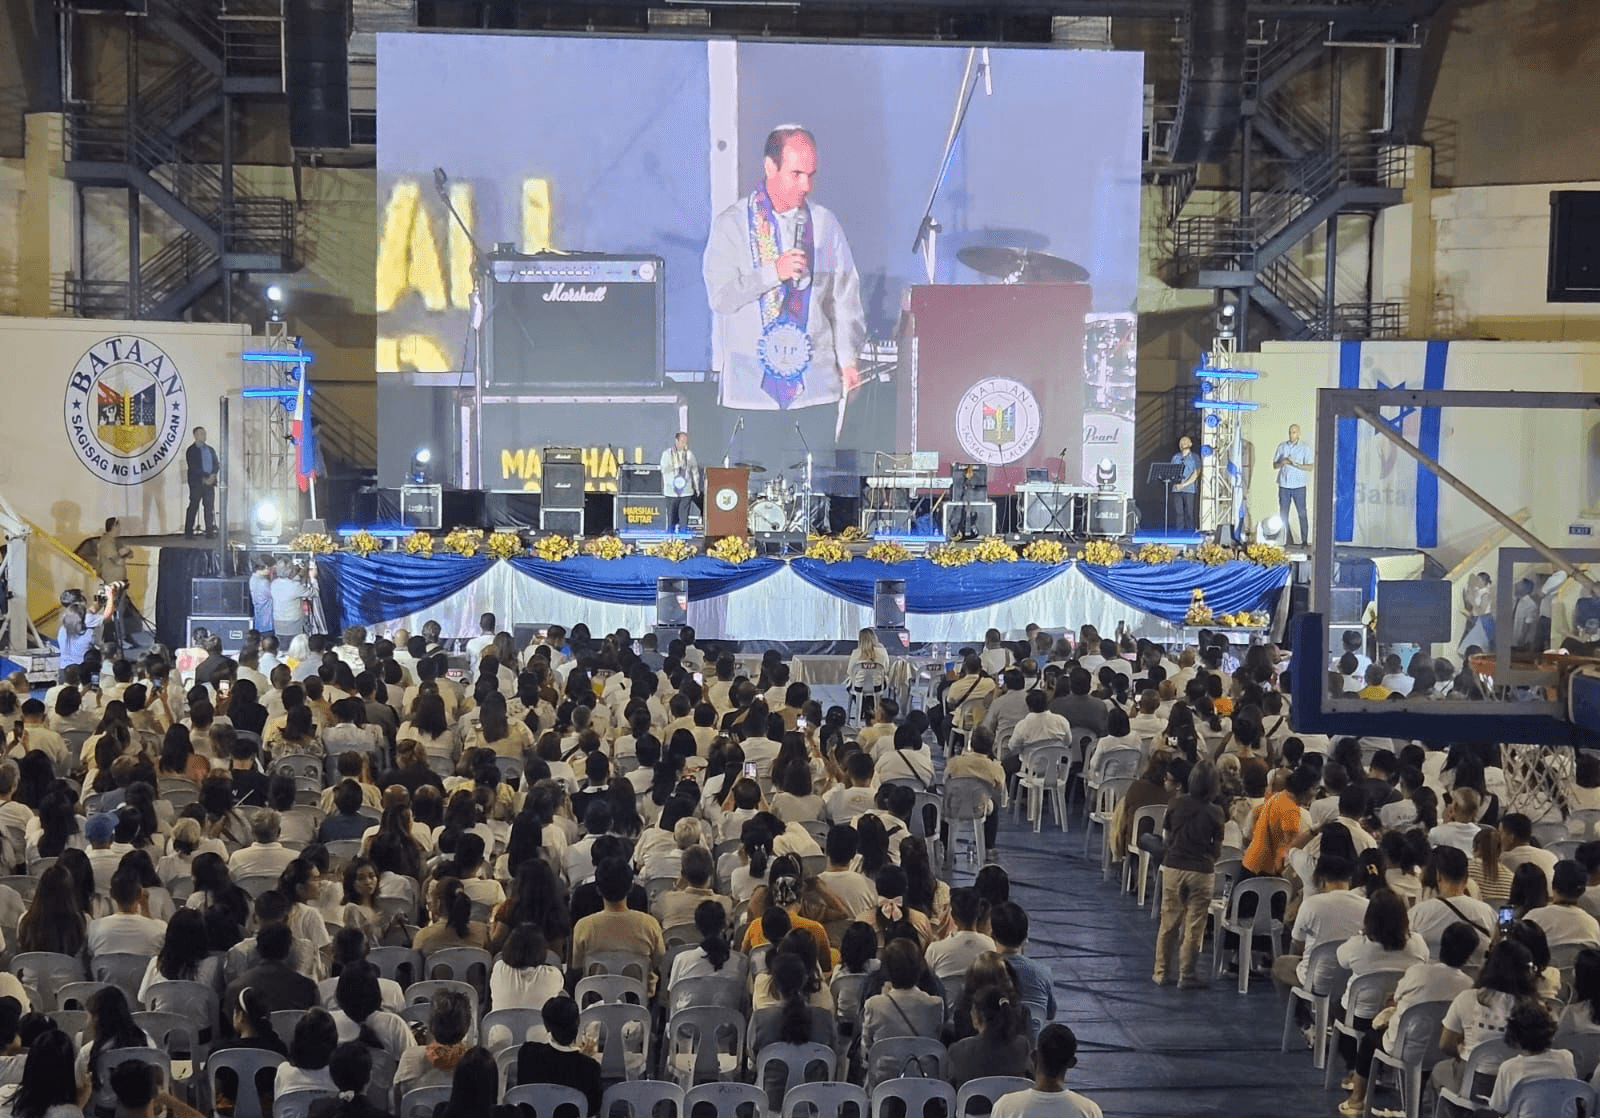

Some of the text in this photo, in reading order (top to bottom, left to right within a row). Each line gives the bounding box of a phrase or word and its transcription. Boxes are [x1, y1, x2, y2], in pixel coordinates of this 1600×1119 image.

[543, 283, 607, 302] Marshall
[774, 344, 798, 356] VIP
[70, 338, 183, 397] BATAAN
[1084, 424, 1119, 443] Pearl
[71, 414, 181, 477] SAGISAG NG LALAWIGAN
[623, 506, 660, 516] MARSHALL
